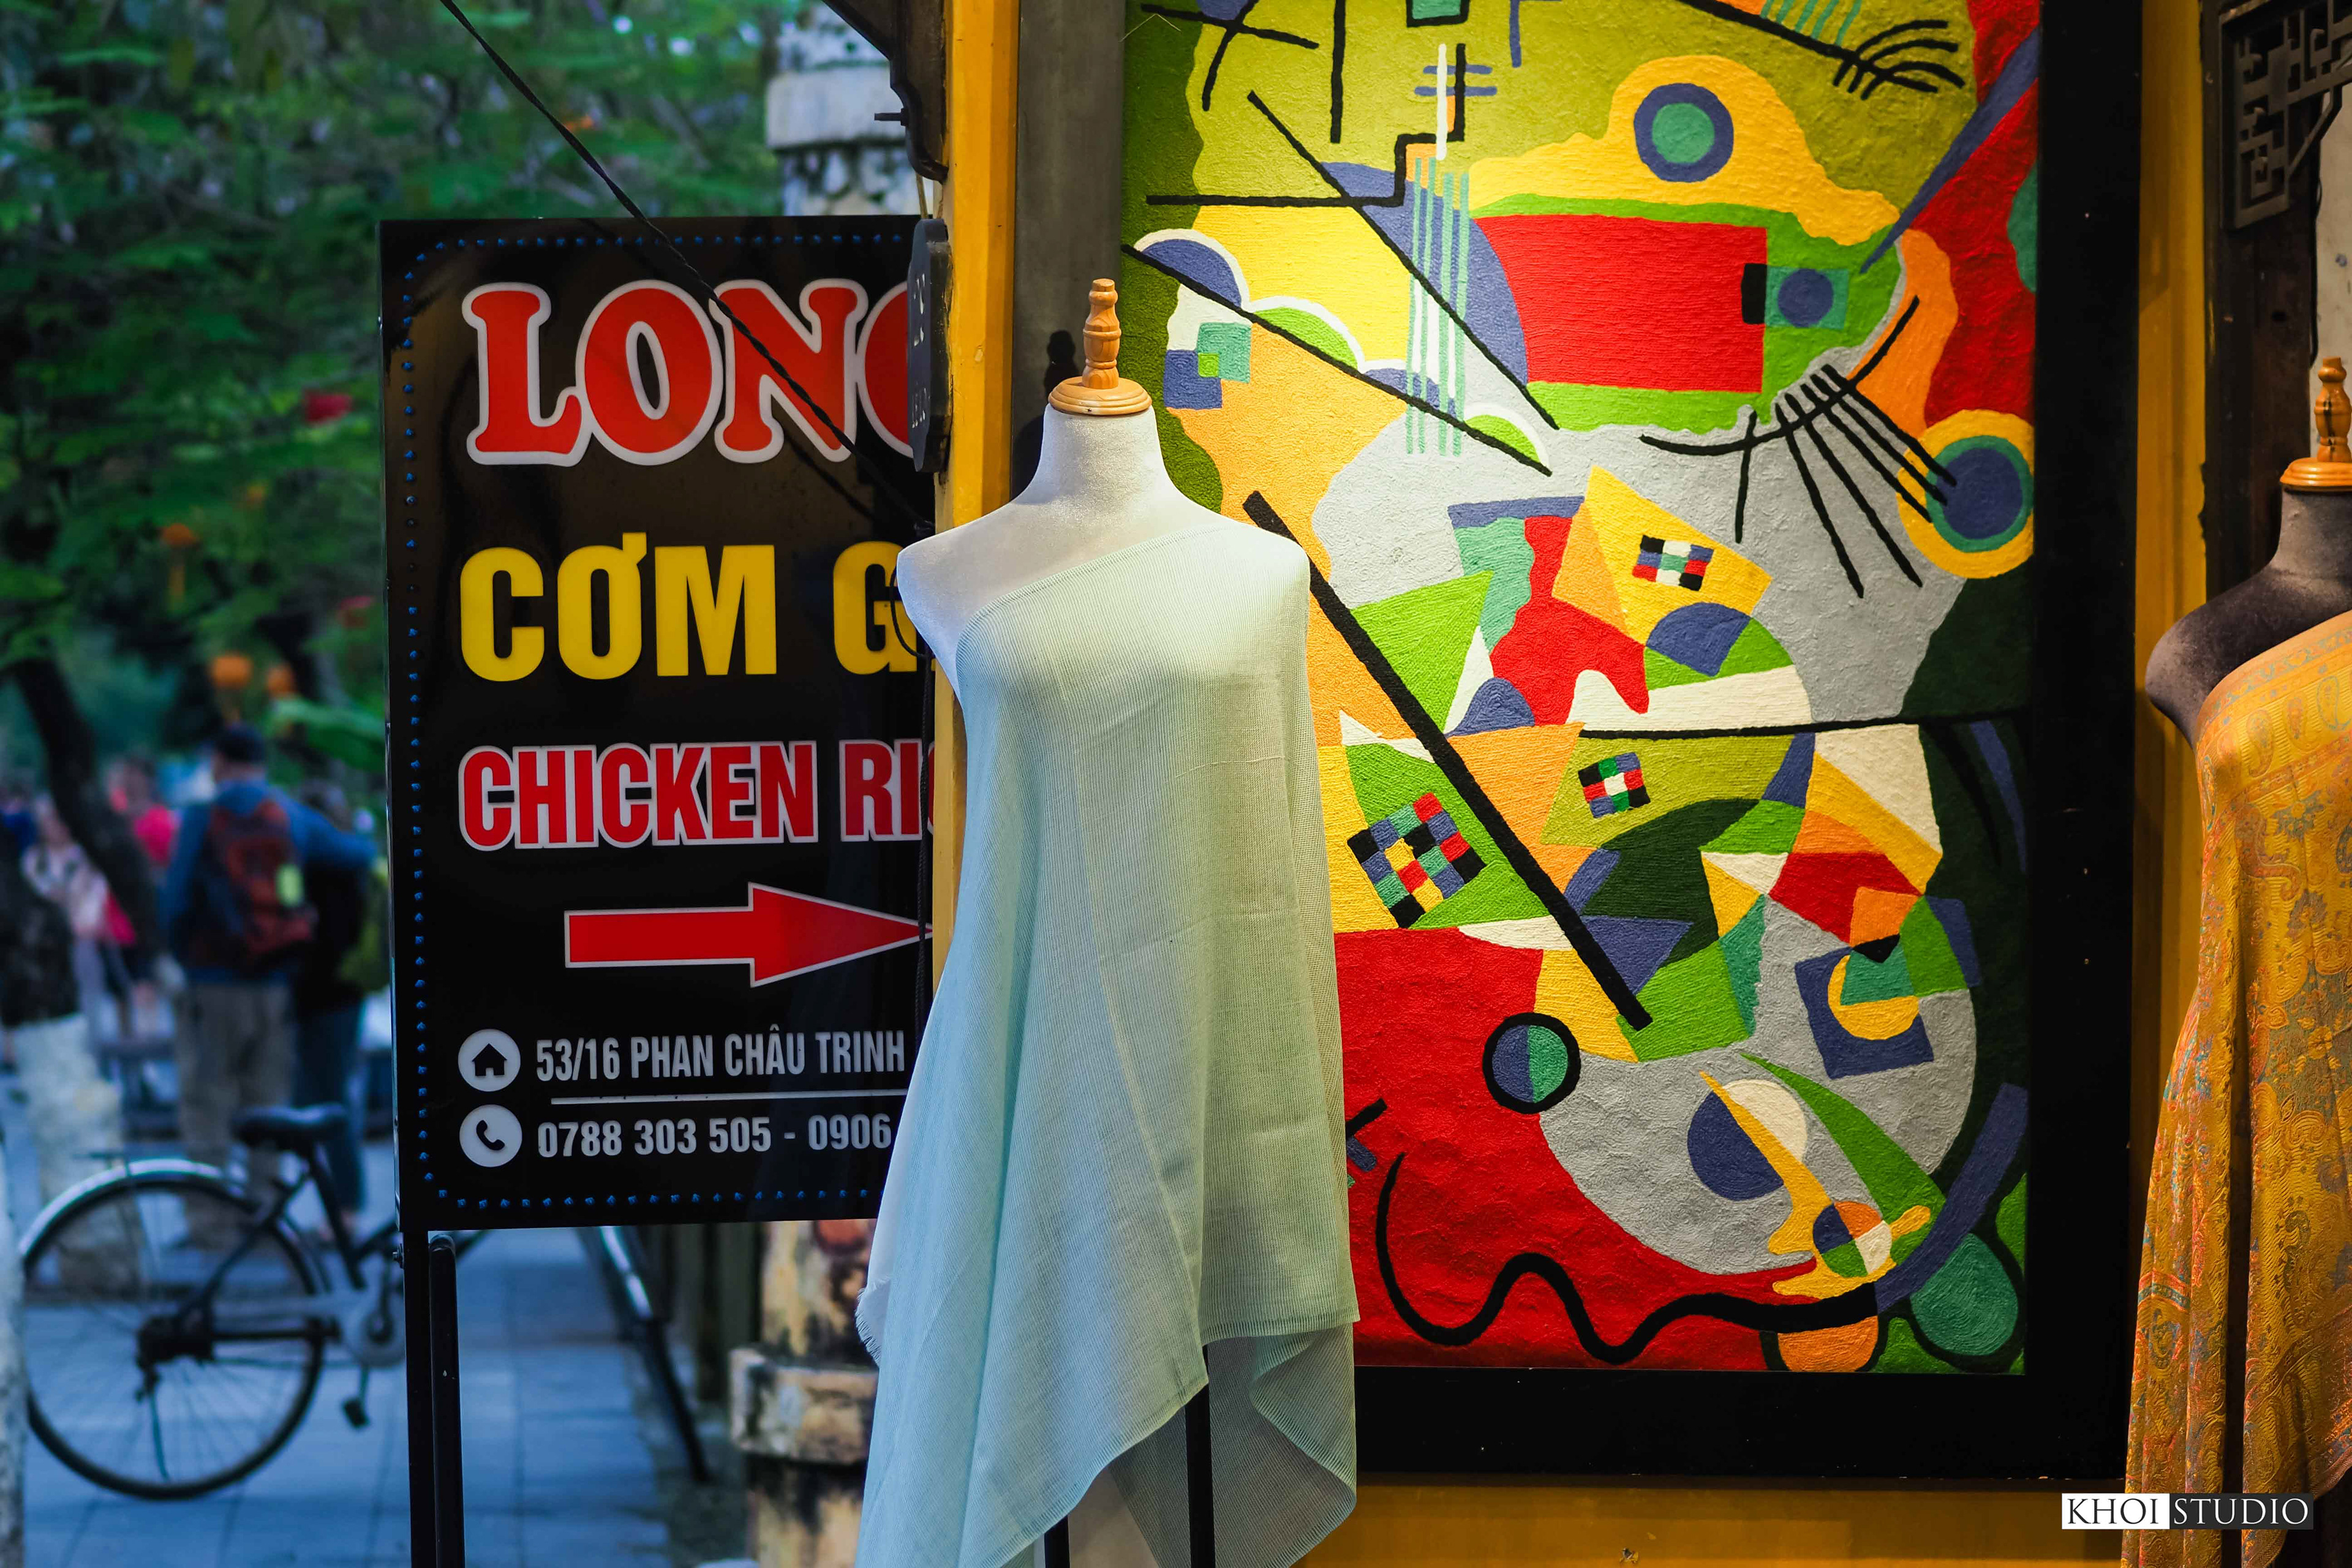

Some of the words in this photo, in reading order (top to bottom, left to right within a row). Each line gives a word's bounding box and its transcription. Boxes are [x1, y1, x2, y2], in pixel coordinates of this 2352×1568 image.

[460, 532, 777, 681] CƠM
[833, 541, 936, 675] G
[458, 741, 818, 851] CHICKEN
[839, 738, 935, 842] RI
[537, 1038, 620, 1081] 53/16
[630, 1035, 714, 1078] PHAN
[725, 1023, 805, 1076] CHÂU
[815, 1030, 905, 1074] TRINH
[538, 1120, 622, 1158] 0788
[634, 1118, 696, 1155] 303
[709, 1117, 771, 1153] 505
[808, 1113, 891, 1150] 0906
